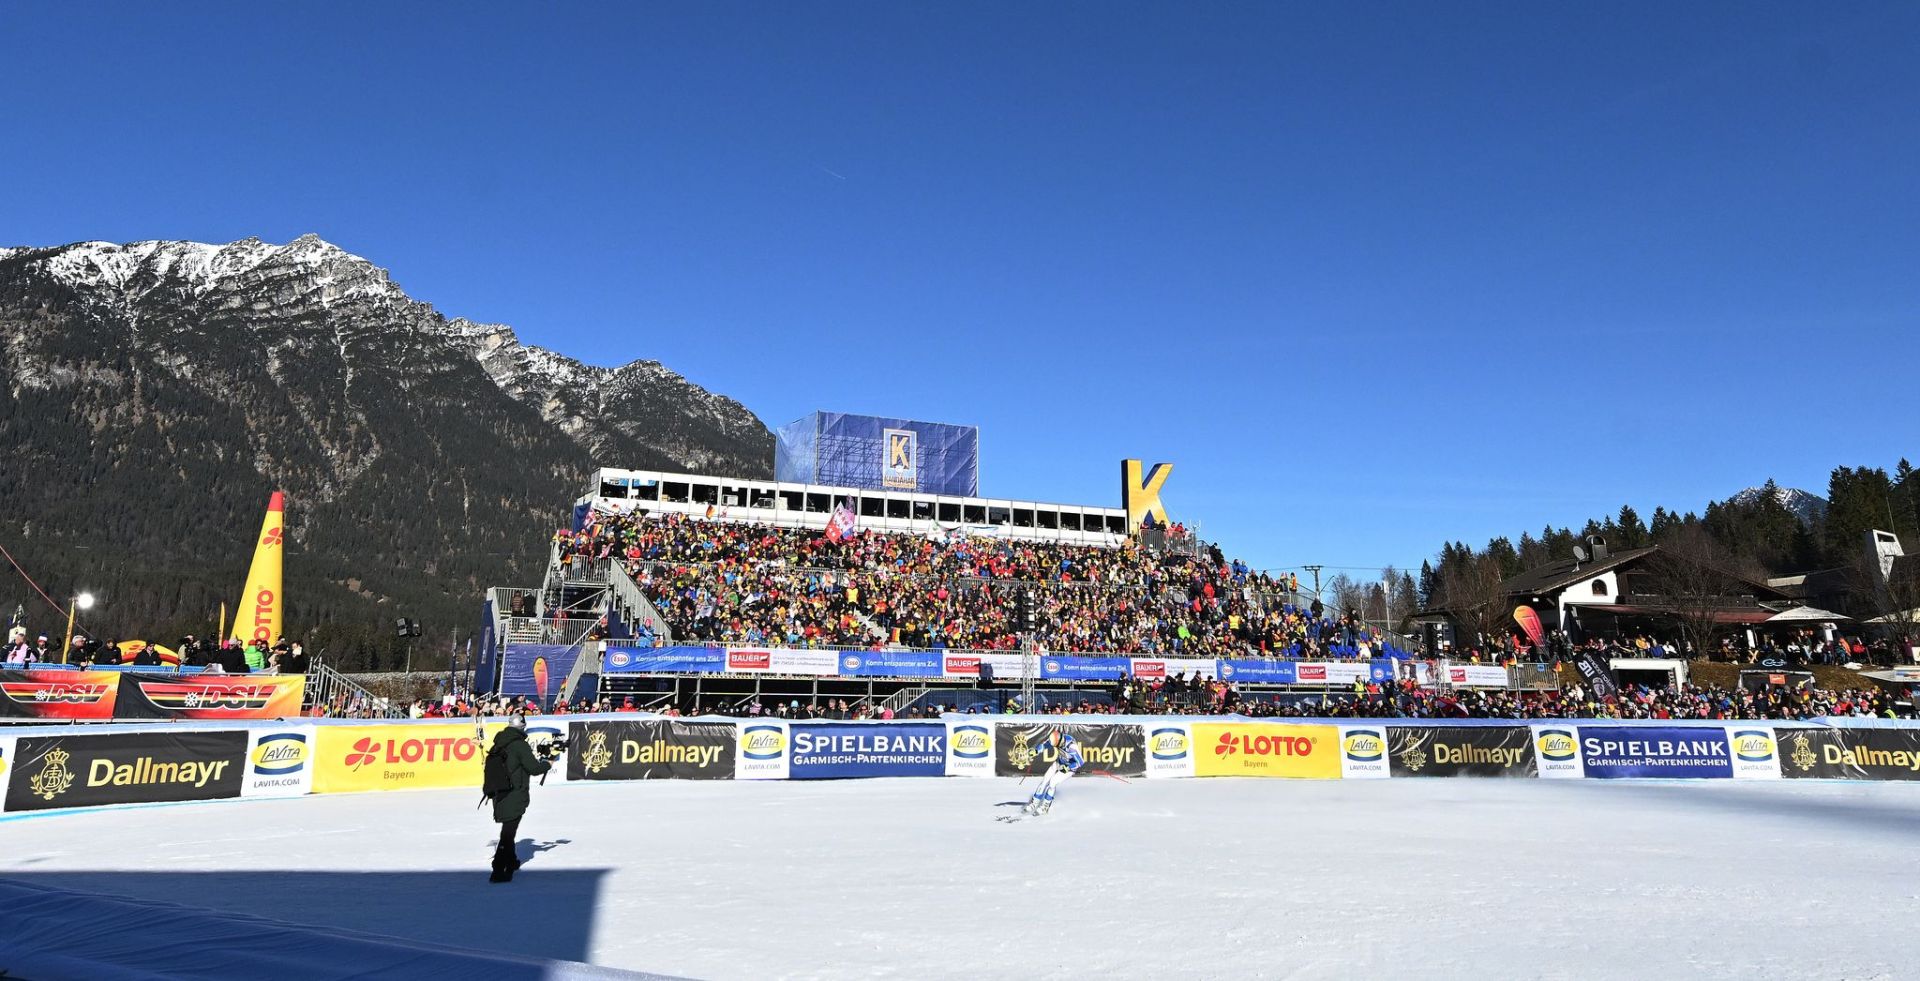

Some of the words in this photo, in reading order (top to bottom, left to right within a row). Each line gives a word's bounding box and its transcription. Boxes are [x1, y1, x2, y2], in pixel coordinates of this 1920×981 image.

[891, 435, 910, 469] K
[1121, 459, 1174, 537] K
[254, 590, 274, 641] OTTO
[47, 684, 109, 703] DSV
[201, 683, 276, 709] DSV
[386, 737, 475, 764] LOTTO
[621, 740, 724, 768] Dallmayr
[794, 733, 943, 754] SPIELBANK
[1043, 741, 1135, 768] Dlmayr
[1243, 735, 1313, 757] LOTTO
[1434, 743, 1524, 767] Dallmayr
[1584, 738, 1727, 756] SPIELBANK
[793, 754, 943, 765] GARMISCH-PARTENKIRCHEN
[1243, 759, 1268, 768] Bayern
[1587, 757, 1729, 767] GARMISCH-PARTENKIRCHEN
[87, 757, 229, 788] Dallmayr
[254, 778, 300, 788] LAVITA.COM
[383, 770, 415, 781] Bayern
